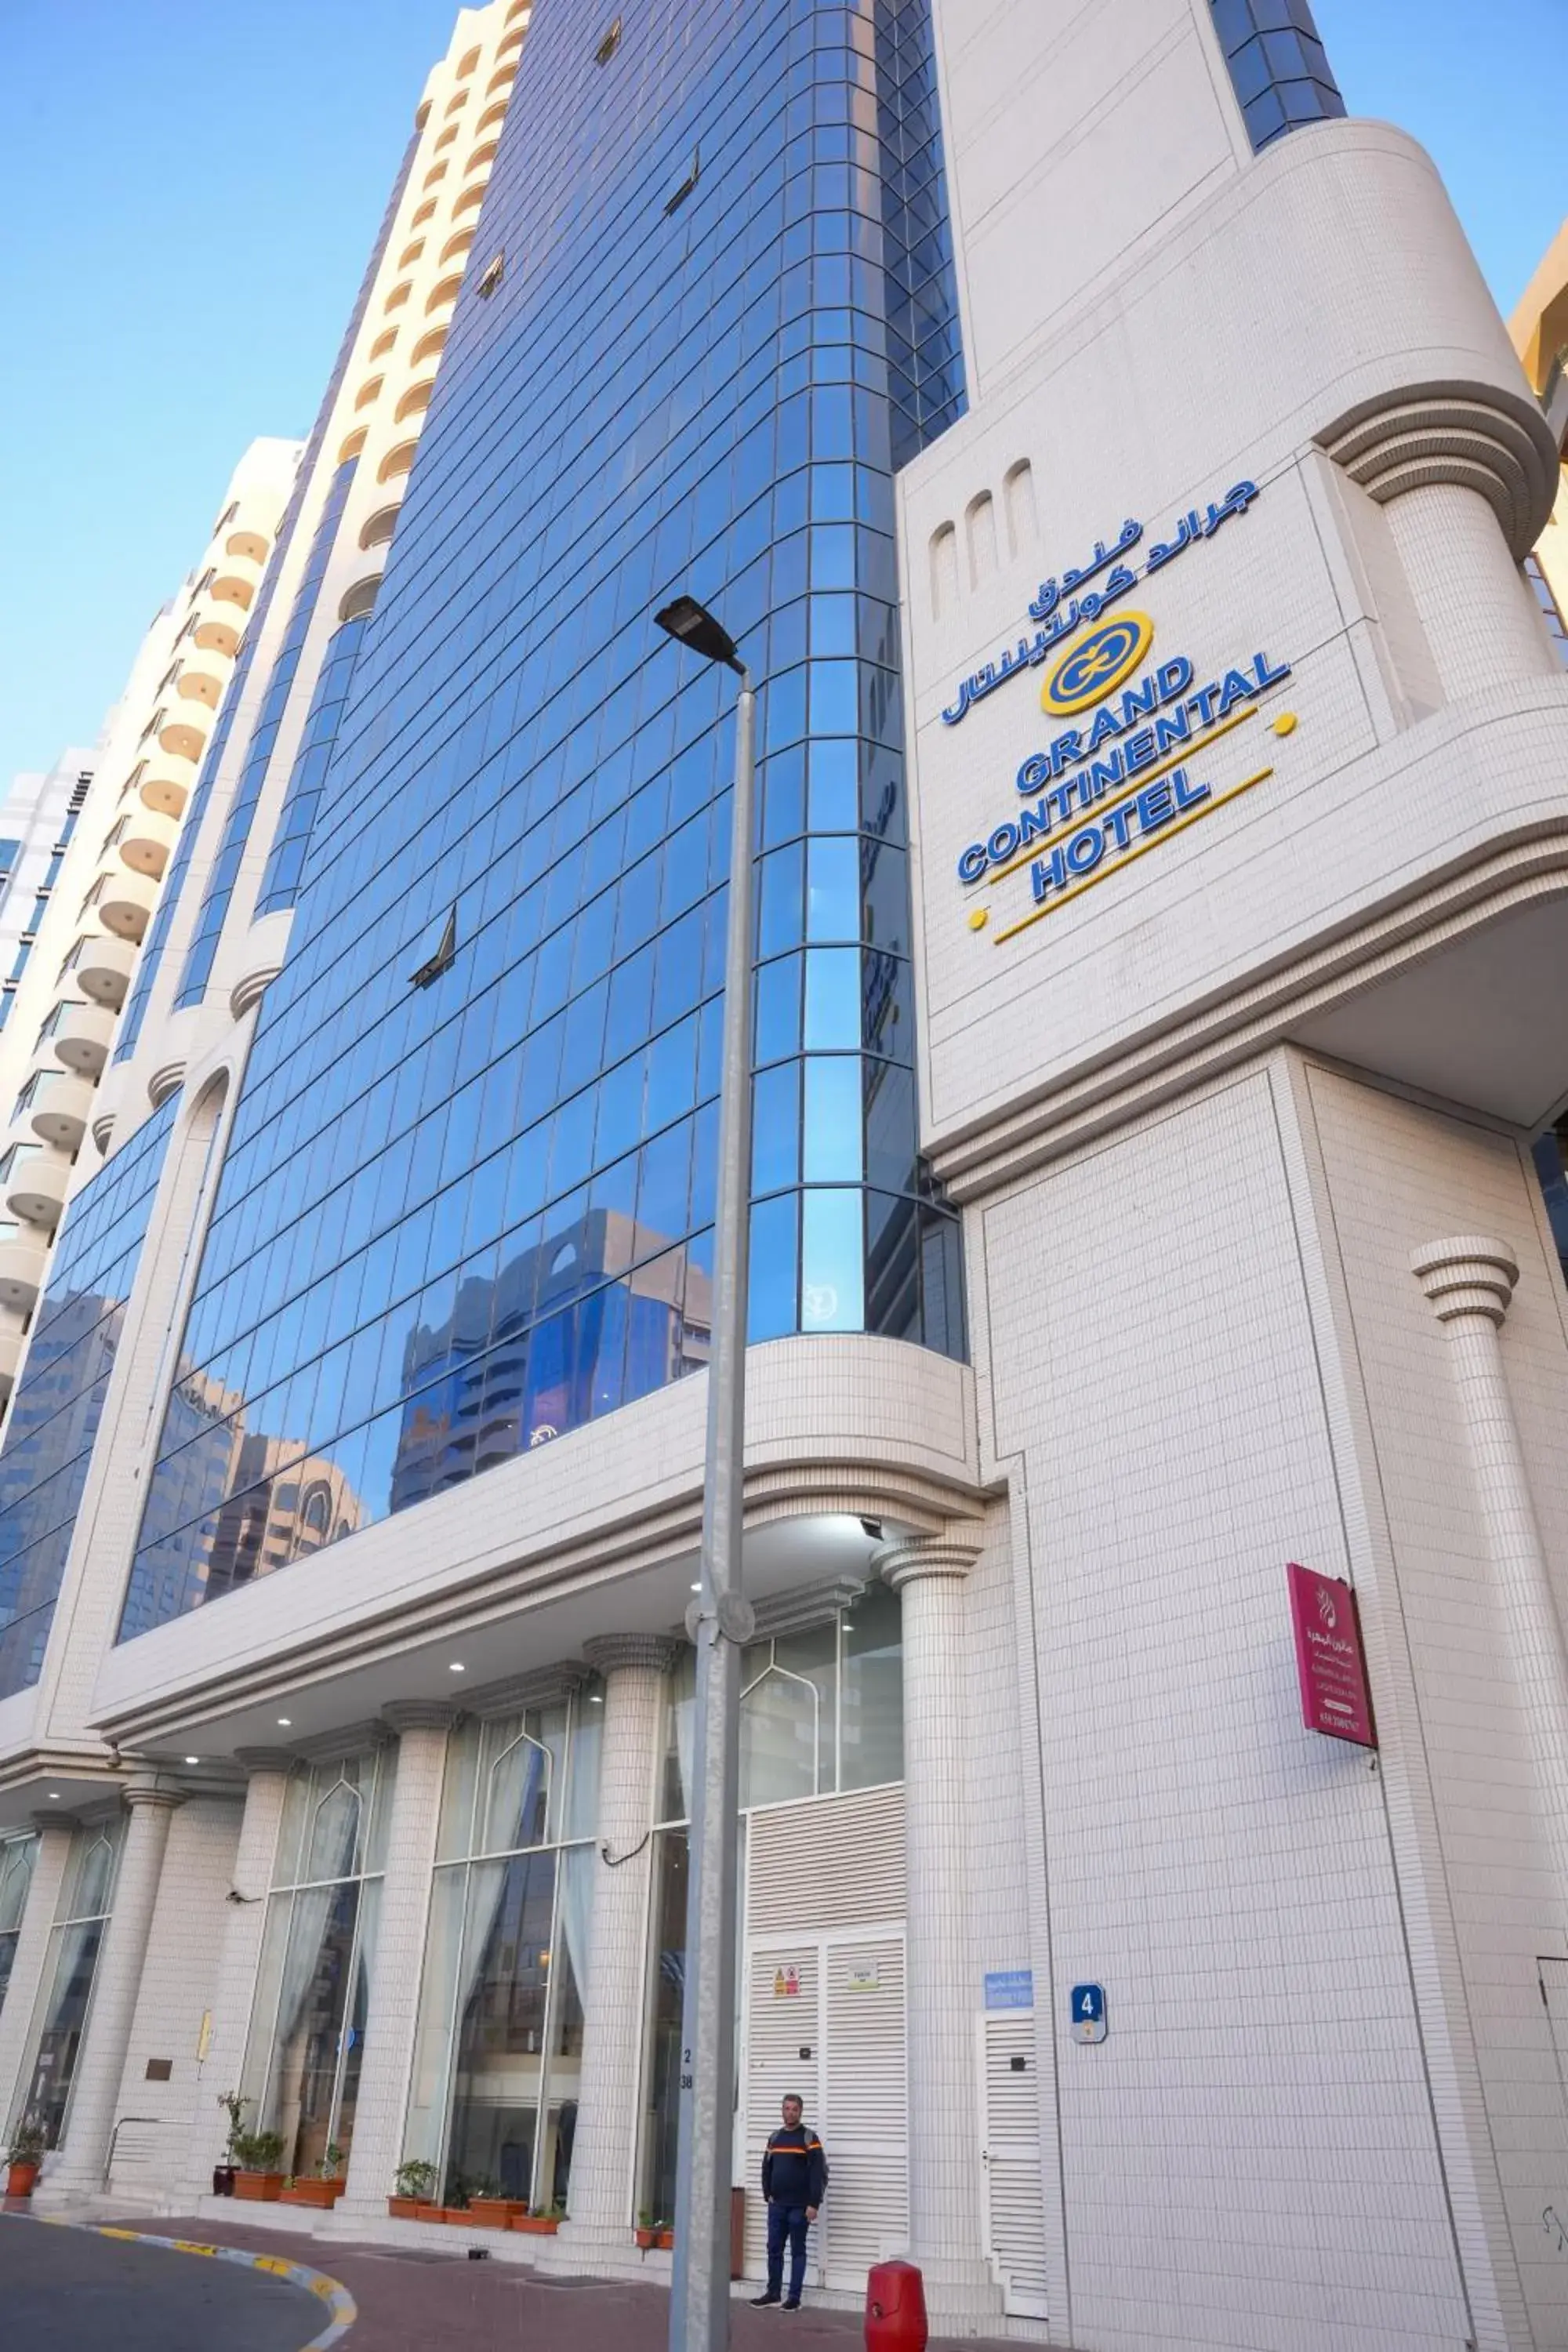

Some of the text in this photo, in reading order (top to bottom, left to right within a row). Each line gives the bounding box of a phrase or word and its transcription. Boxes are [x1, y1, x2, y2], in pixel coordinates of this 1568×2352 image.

[1028, 518, 1143, 620] فندق
[1147, 480, 1258, 572] جراند
[957, 652, 1291, 883] CONTINENTAL
[1016, 655, 1193, 796] GRAND
[1029, 768, 1210, 902] HOTEL
[1081, 1992, 1094, 2014] 4
[684, 2048, 691, 2063] 2
